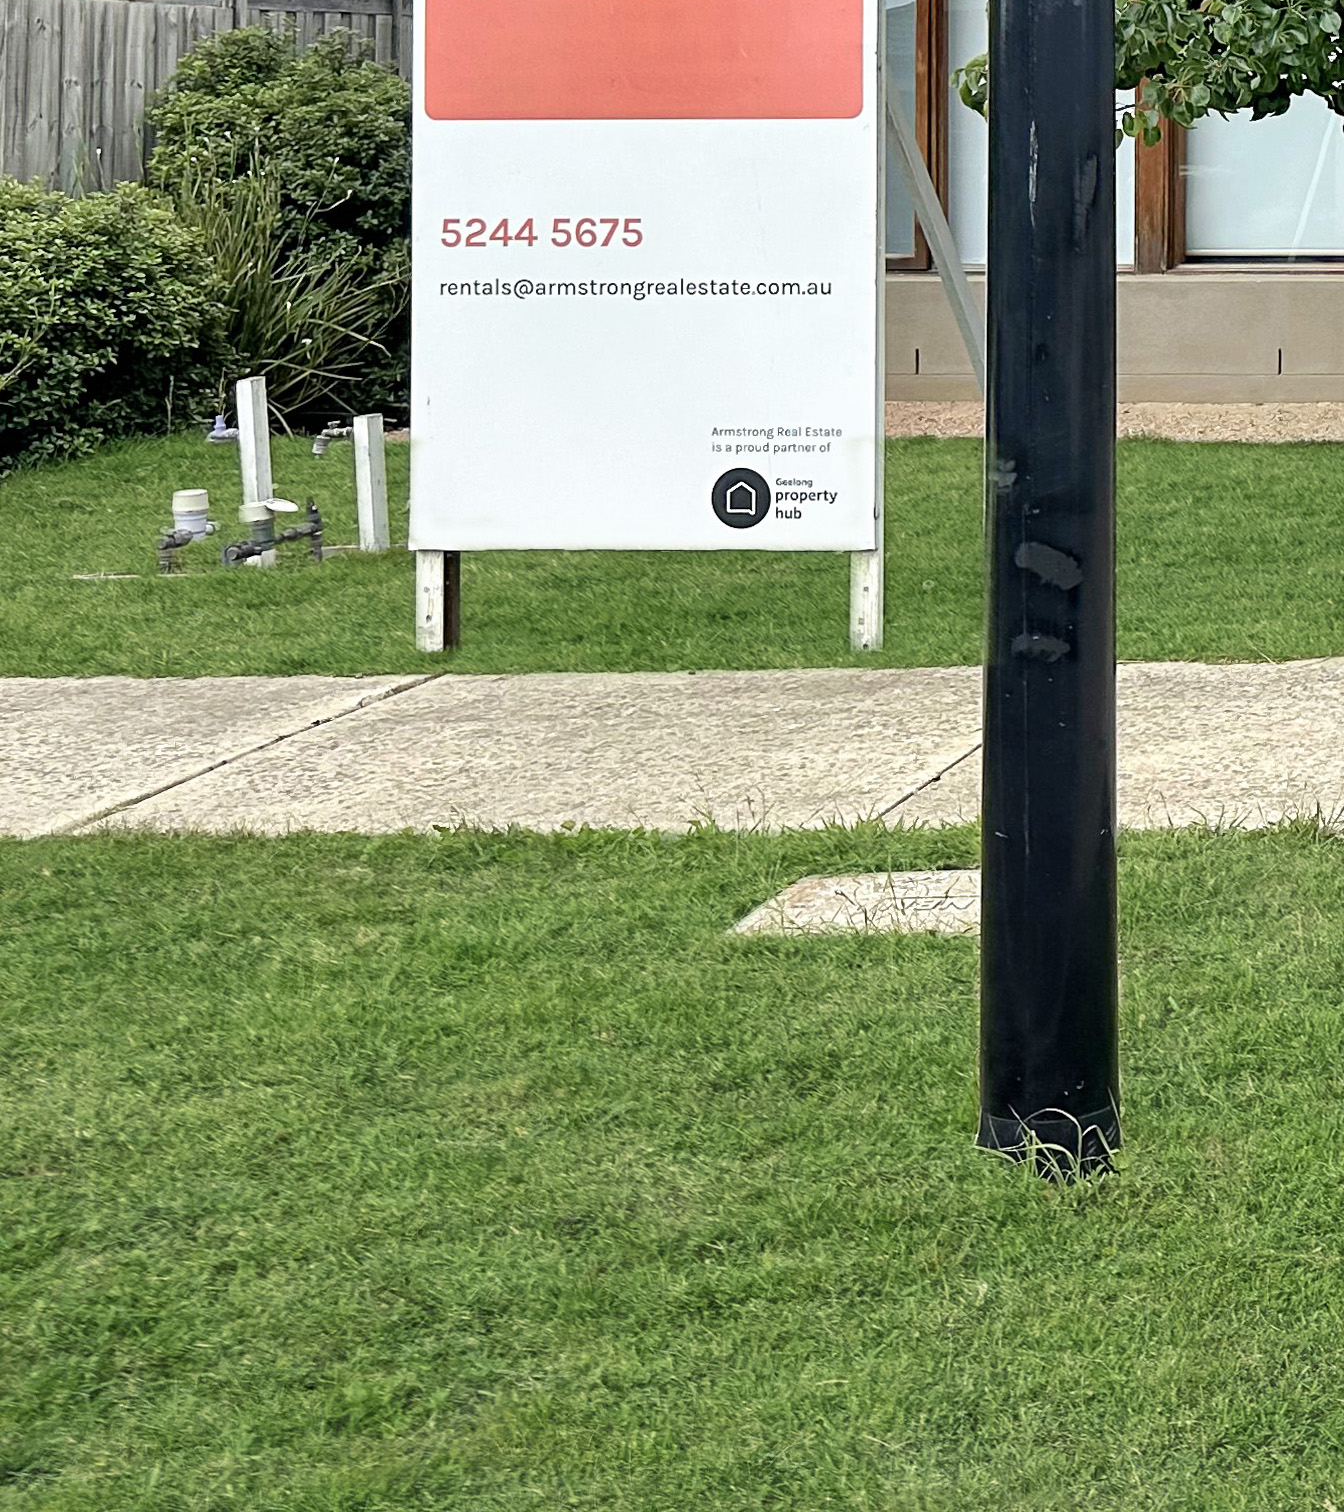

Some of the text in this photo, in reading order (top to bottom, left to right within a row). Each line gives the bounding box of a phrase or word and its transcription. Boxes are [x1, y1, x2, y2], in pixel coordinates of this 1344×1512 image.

[440, 218, 644, 248] 5244 5675
[440, 278, 832, 300] rentals@armstrongrealestate.com.au
[711, 426, 843, 439] Armstrong Real Estate
[712, 442, 831, 455] is a proud partner of
[775, 477, 813, 488] Geelong
[775, 489, 838, 504] property
[775, 507, 802, 520] hub
